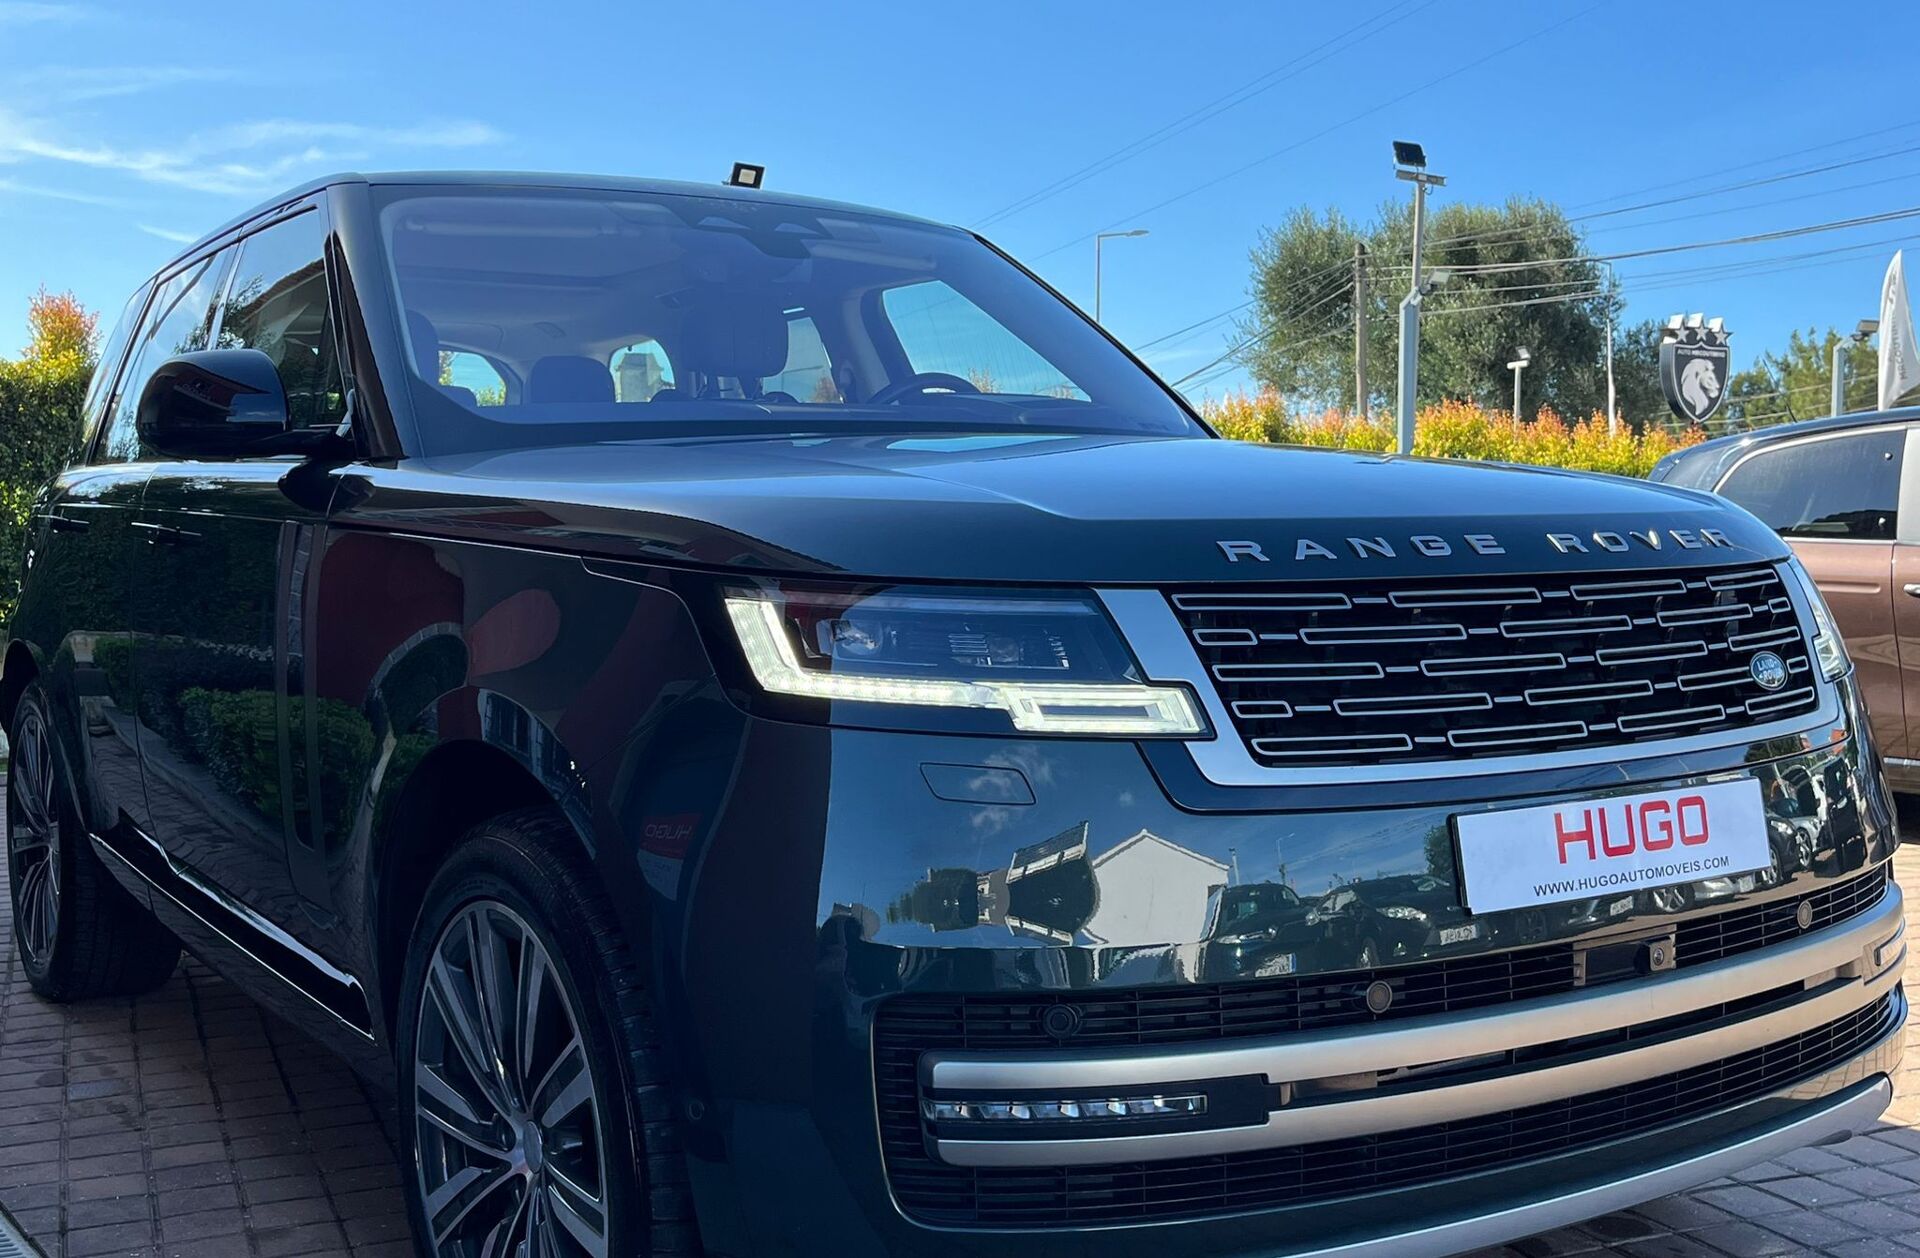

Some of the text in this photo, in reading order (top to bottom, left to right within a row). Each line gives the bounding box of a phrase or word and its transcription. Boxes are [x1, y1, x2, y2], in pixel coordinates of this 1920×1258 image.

[1216, 528, 1735, 562] RANGE ROVER
[1553, 796, 1709, 864] HUGO
[1533, 856, 1730, 897] WWW.HUGOAUTOMOVEIS.COM
